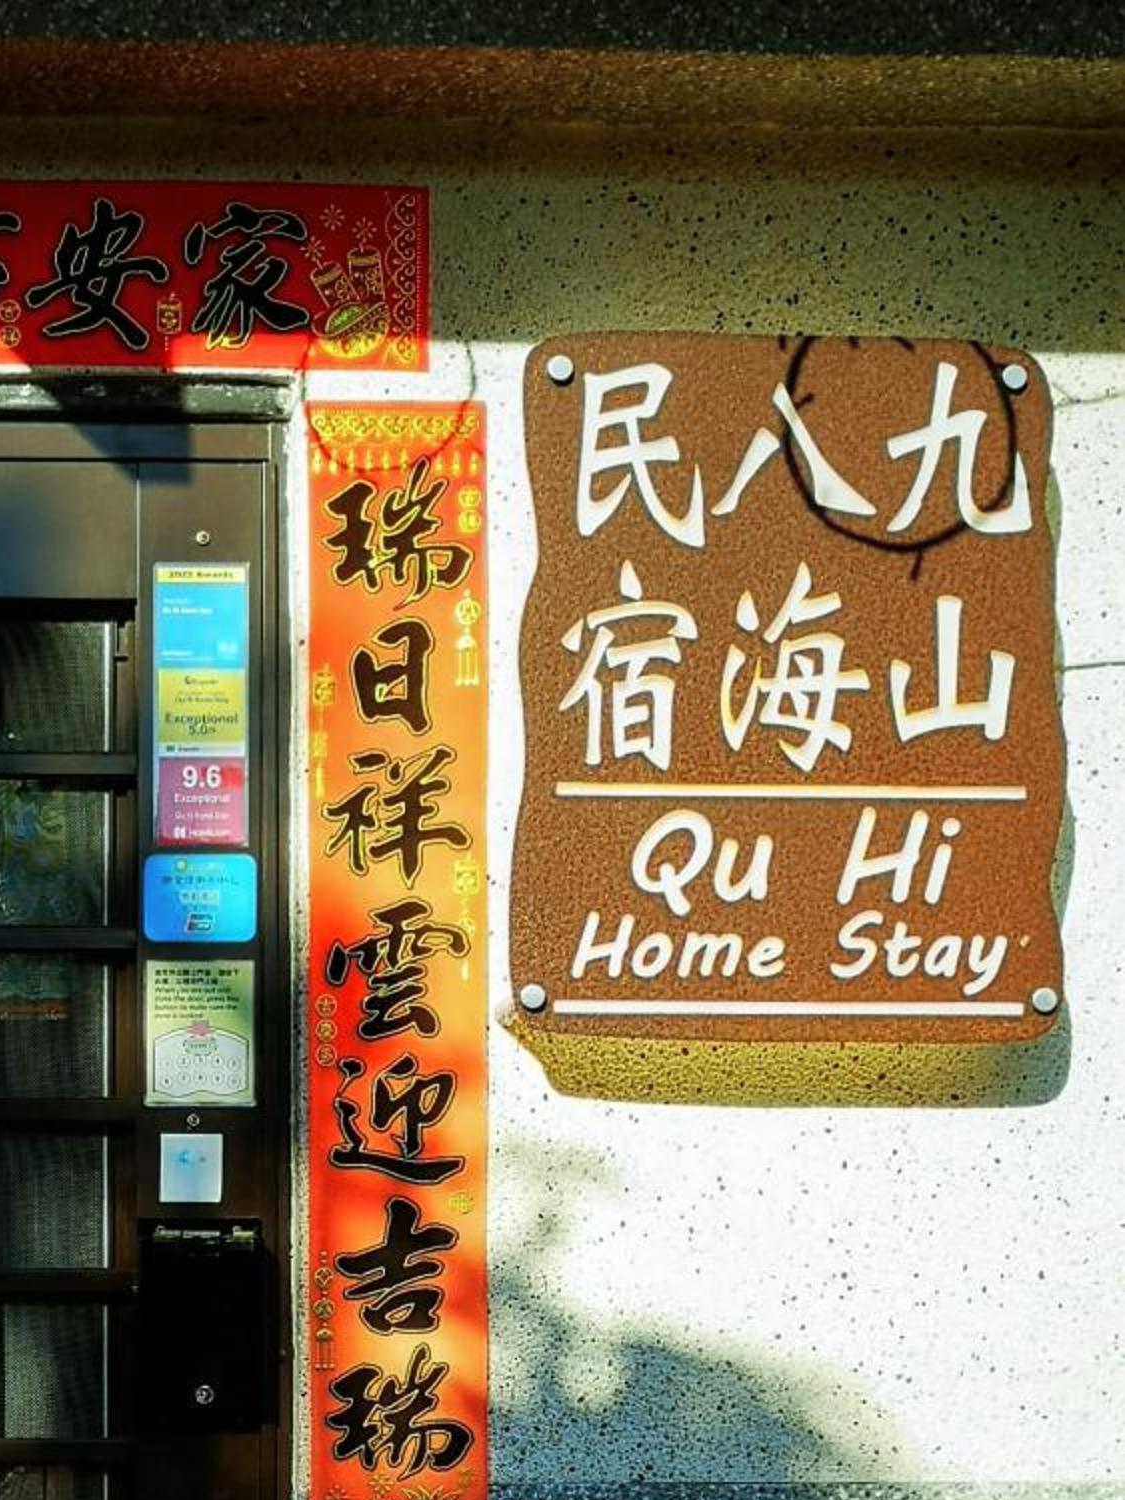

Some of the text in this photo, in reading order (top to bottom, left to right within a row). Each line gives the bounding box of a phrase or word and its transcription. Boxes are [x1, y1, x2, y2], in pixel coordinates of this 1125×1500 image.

[164, 711, 239, 725] Exceptional
[182, 764, 221, 788] 9.6
[631, 806, 962, 916] Qu Hi
[571, 909, 1009, 996] Home Stay
